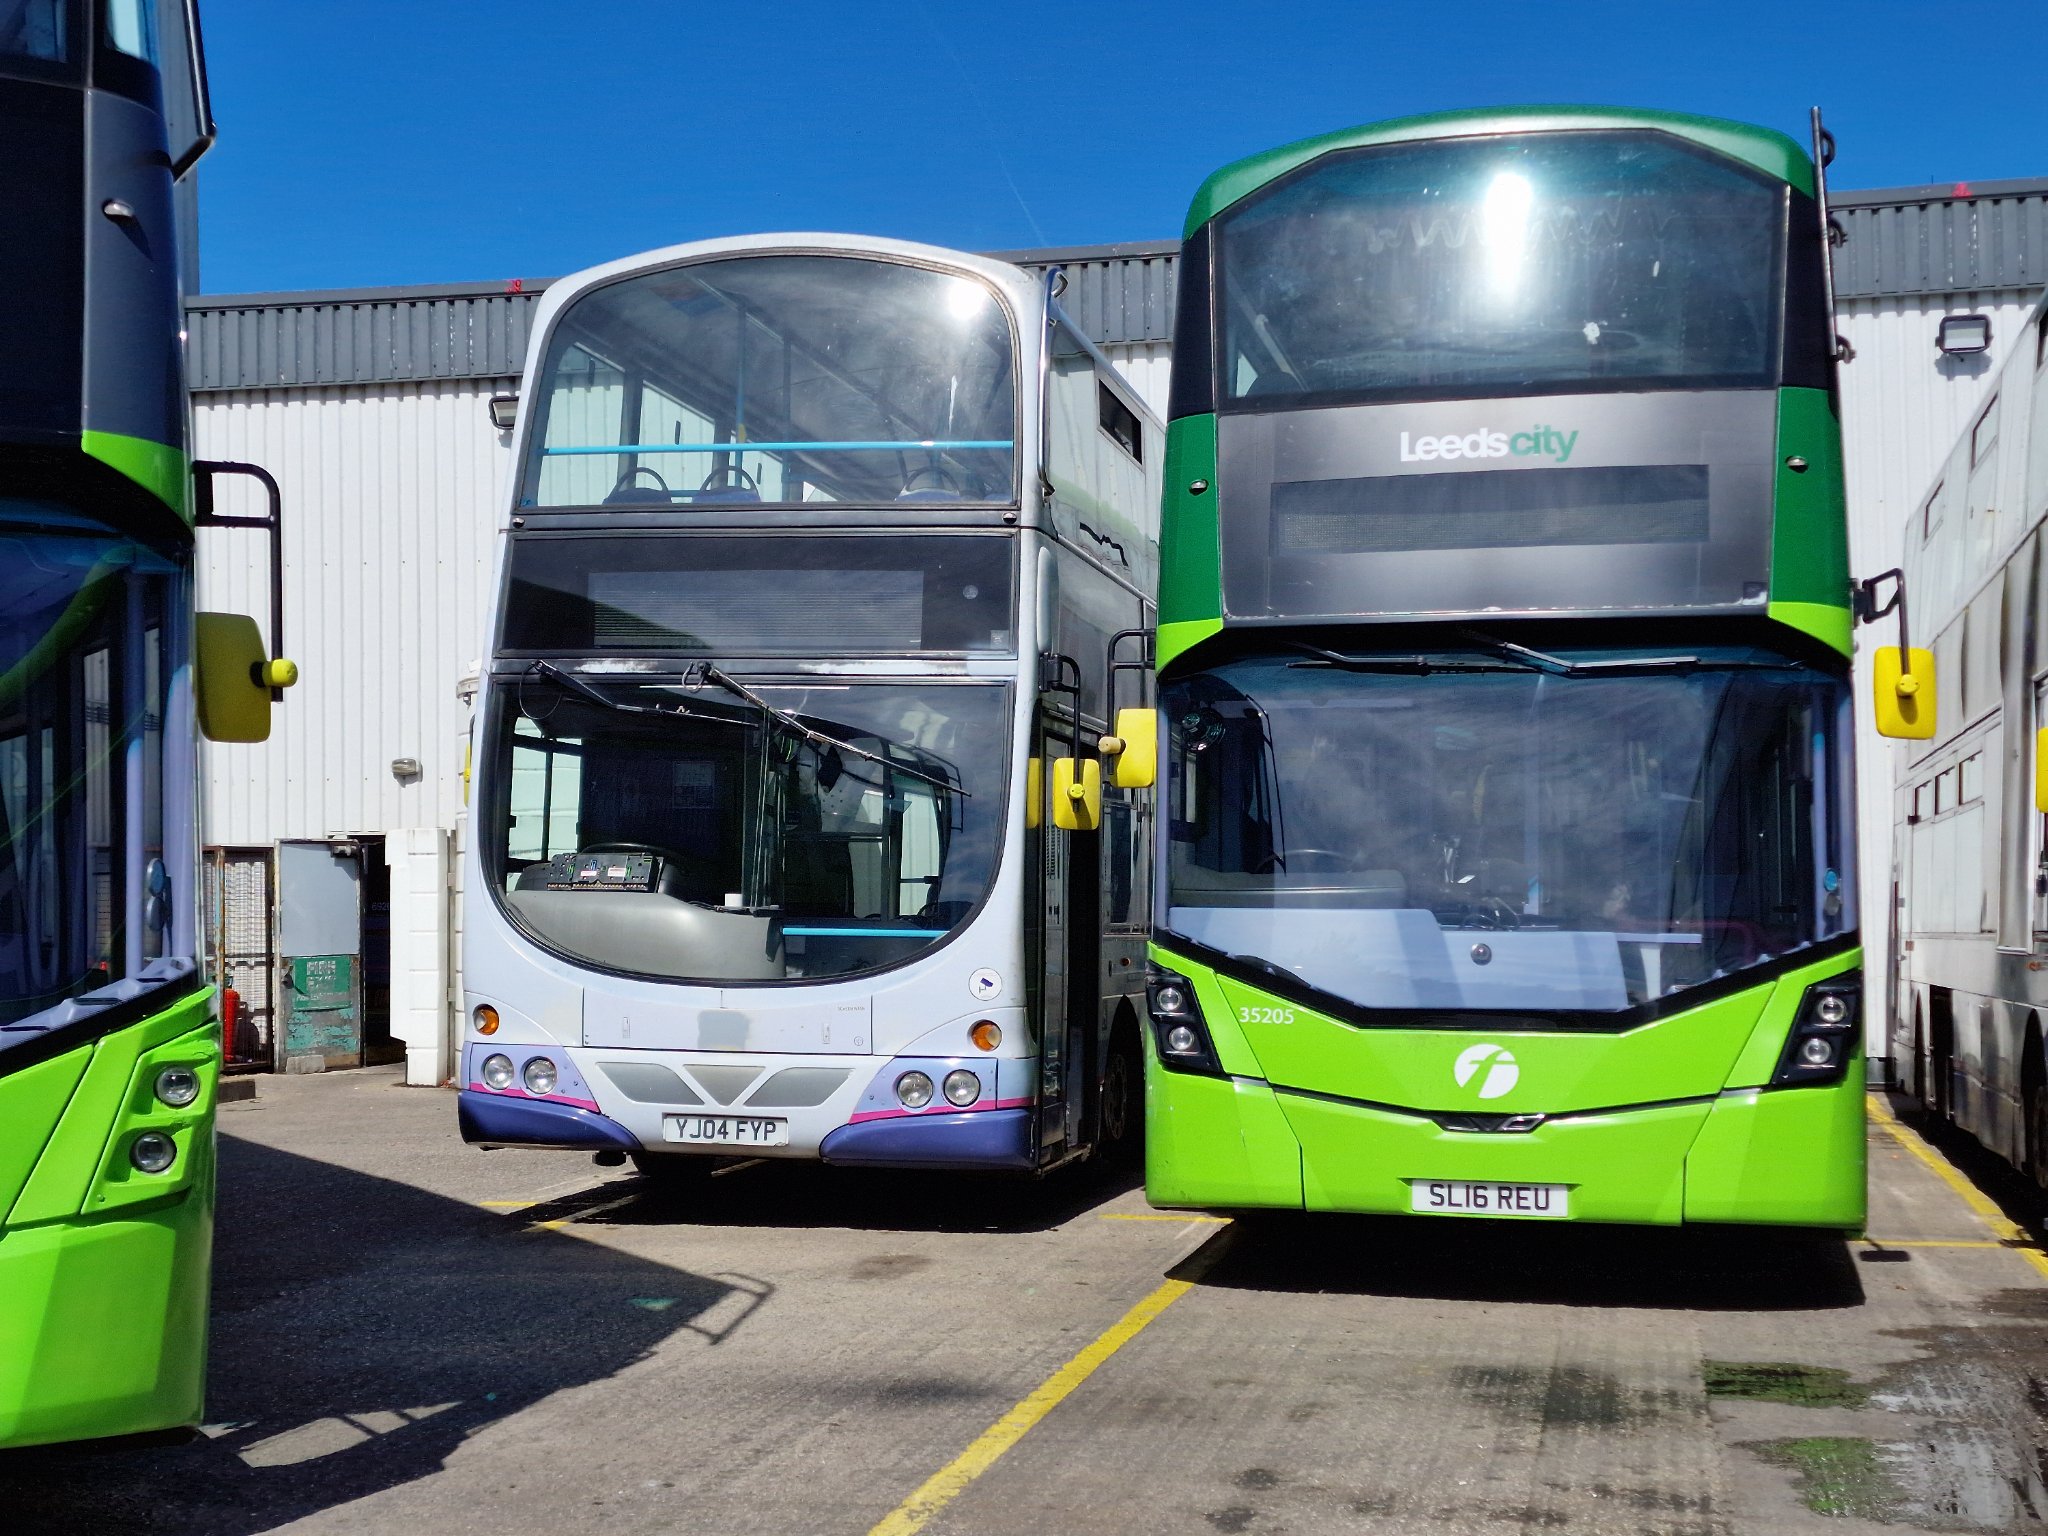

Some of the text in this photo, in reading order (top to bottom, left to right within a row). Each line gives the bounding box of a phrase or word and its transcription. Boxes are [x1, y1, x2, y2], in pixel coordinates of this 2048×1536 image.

[1400, 424, 1579, 462] Leedscity
[1239, 1007, 1295, 1025] 35205
[675, 1118, 777, 1141] YJ04 FYP
[1429, 1183, 1550, 1211] SL16 REU
